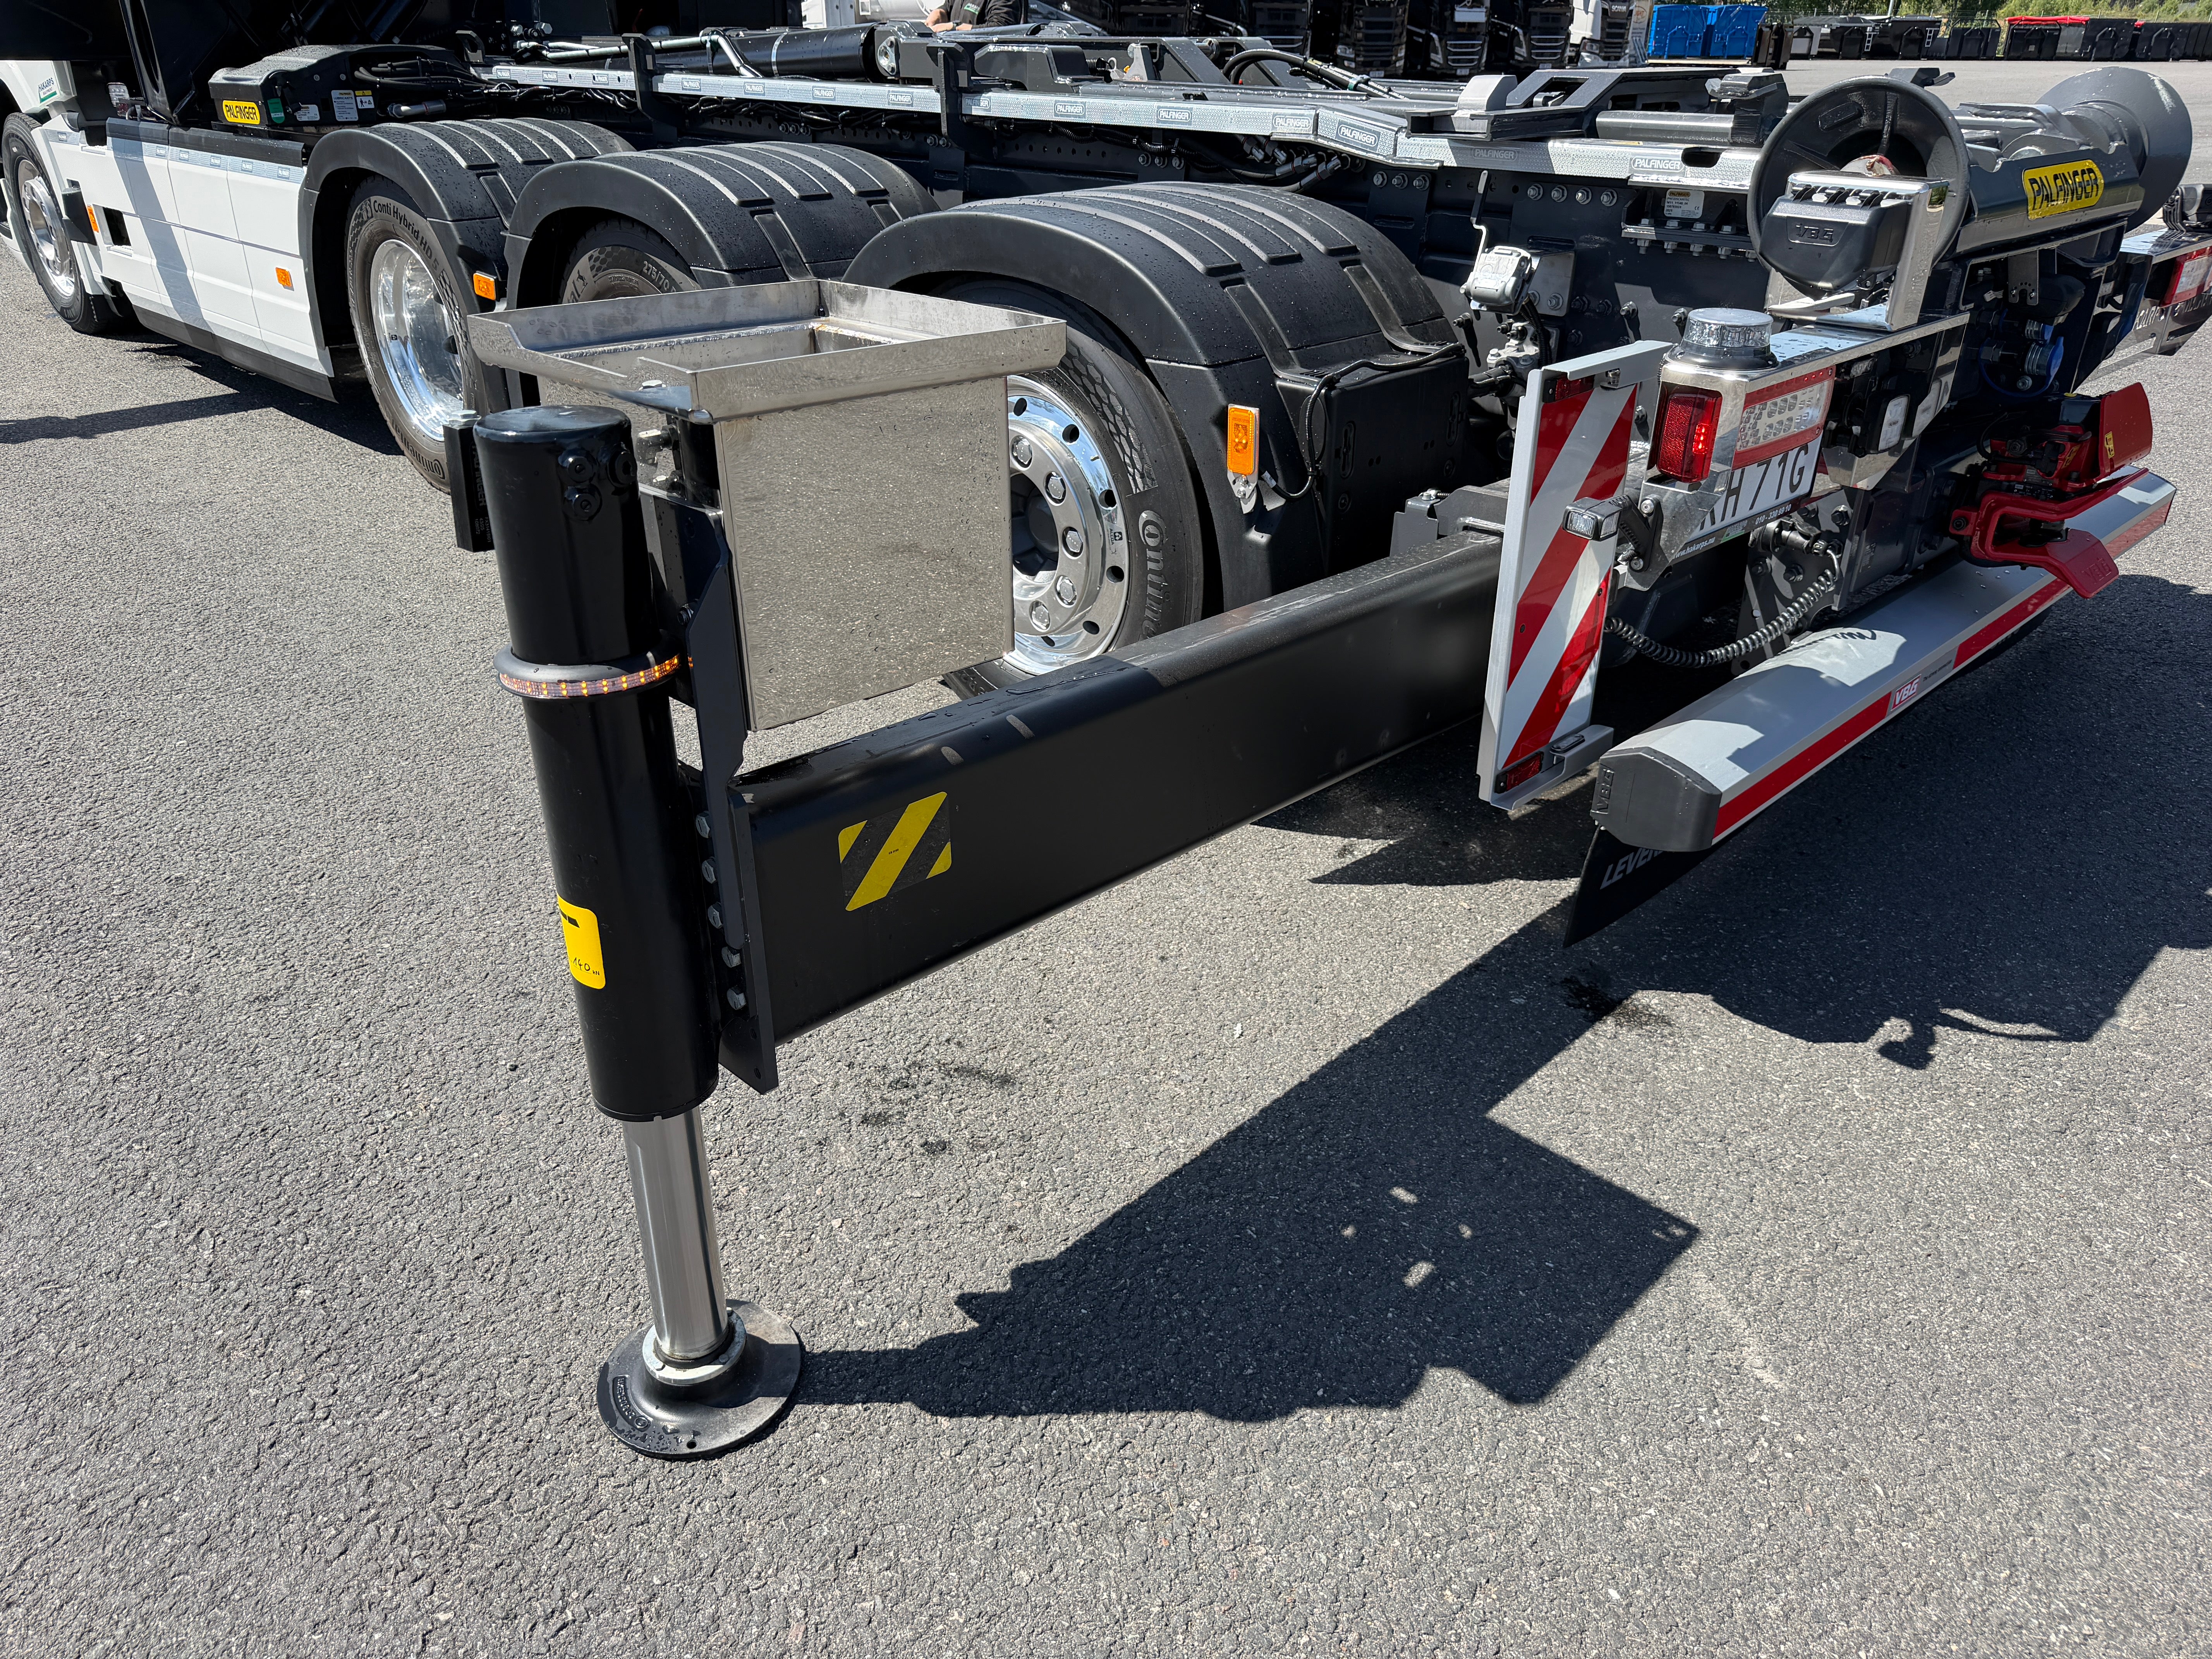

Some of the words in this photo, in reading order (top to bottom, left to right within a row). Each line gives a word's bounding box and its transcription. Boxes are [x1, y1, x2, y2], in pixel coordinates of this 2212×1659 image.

[965, 98, 989, 106] PALFINGER
[1057, 105, 1083, 113] PALFINGER
[225, 104, 258, 120] PALFINGER
[1159, 110, 1188, 120] PALFINGER
[1275, 117, 1310, 127] PALFINGER
[1340, 127, 1375, 145] PALFINGER
[1474, 149, 1514, 159] PALFINGER
[1634, 159, 1681, 170] PALFINGER
[2028, 168, 2099, 211] PALFINGER
[373, 200, 392, 216] Conti
[393, 205, 420, 241] Hybrid
[420, 235, 433, 259] HD
[432, 258, 440, 271] 5
[1796, 225, 1834, 241] VBG
[642, 261, 670, 291] 275/70
[392, 419, 446, 480] Continental
[1749, 444, 1808, 511] 71G
[1755, 515, 1765, 525] 010
[1768, 510, 1778, 520] 330
[1785, 504, 1792, 512] 10
[1895, 678, 1920, 705] VBG
[1597, 769, 1614, 810] VBG
[573, 957, 591, 971] 140
